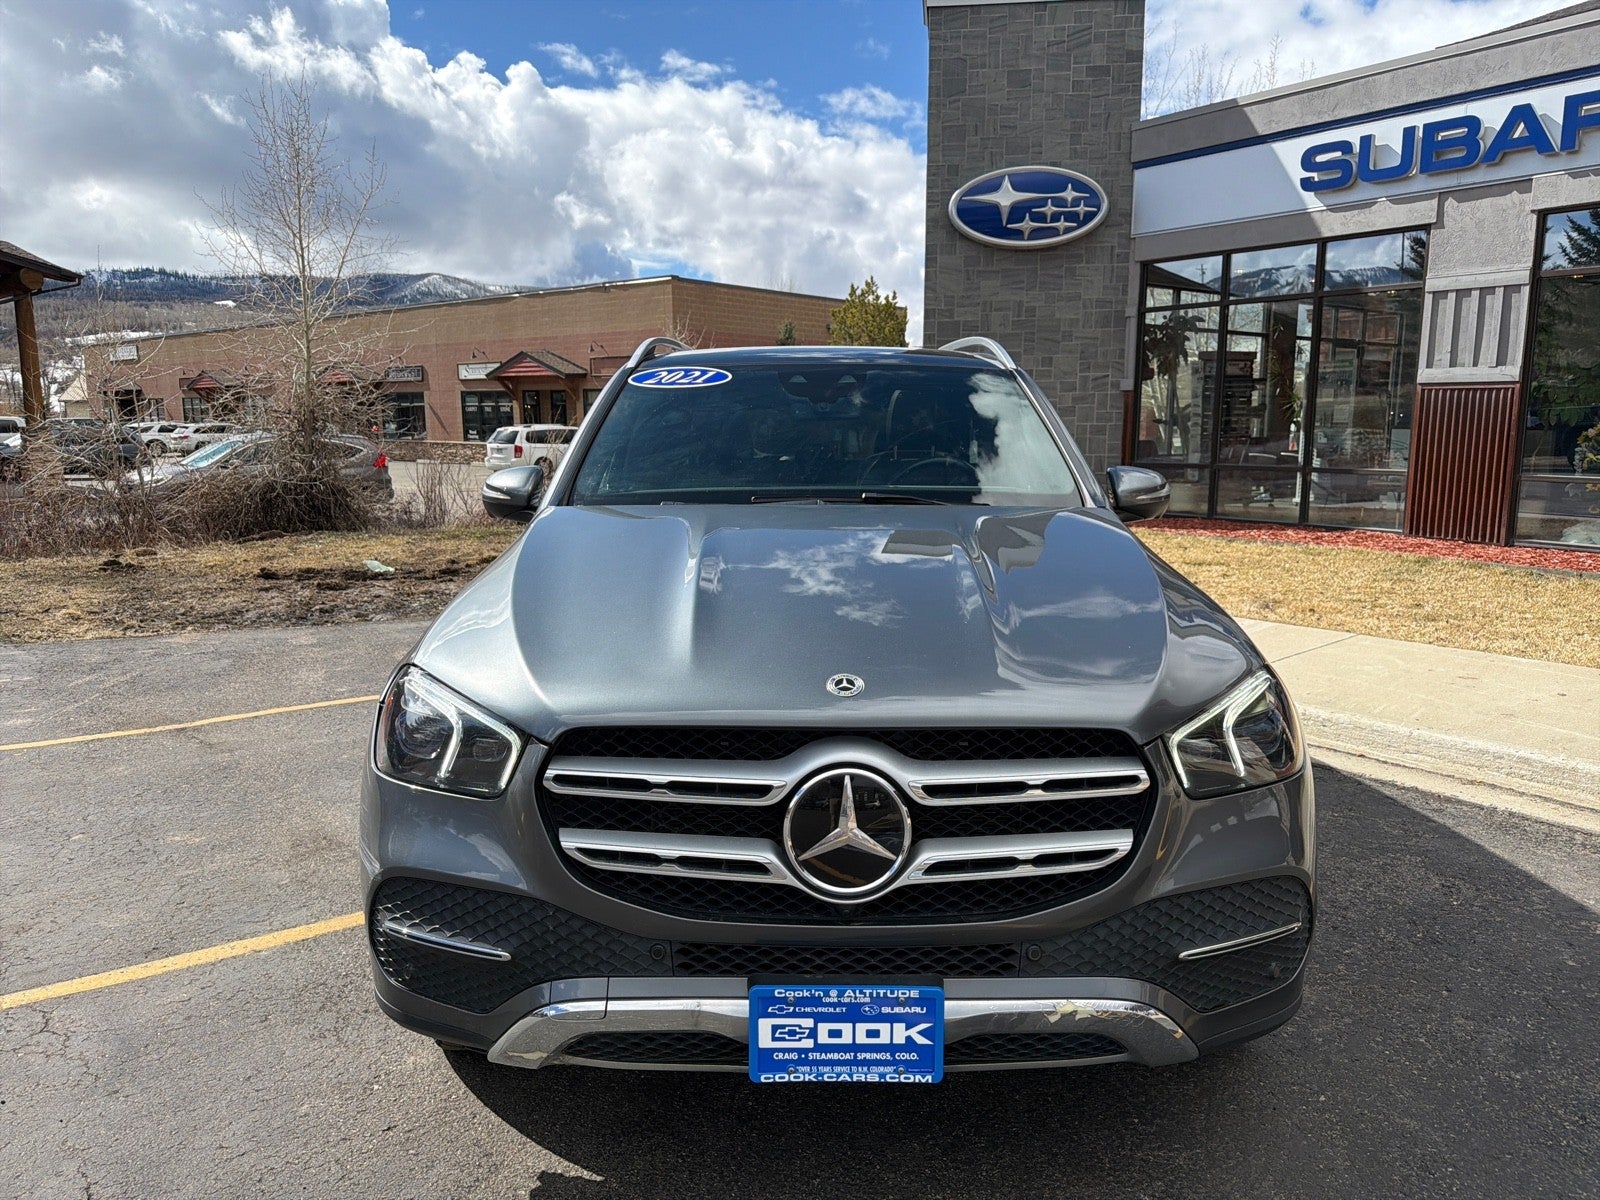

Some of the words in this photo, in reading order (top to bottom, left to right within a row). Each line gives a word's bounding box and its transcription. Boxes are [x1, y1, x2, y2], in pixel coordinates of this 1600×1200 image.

[642, 370, 717, 384] 2021
[774, 989, 824, 998] Cook'n
[844, 989, 920, 998] ALTITUDE
[881, 1006, 927, 1014] SUBARU
[758, 1018, 934, 1049] COOK
[773, 1052, 799, 1060] CRAIG
[808, 1052, 855, 1060] STEAMBOAT
[856, 1052, 893, 1061] SPRINGS,
[895, 1052, 920, 1060] COLO.
[760, 1073, 933, 1083] COOK-CARS.COM
